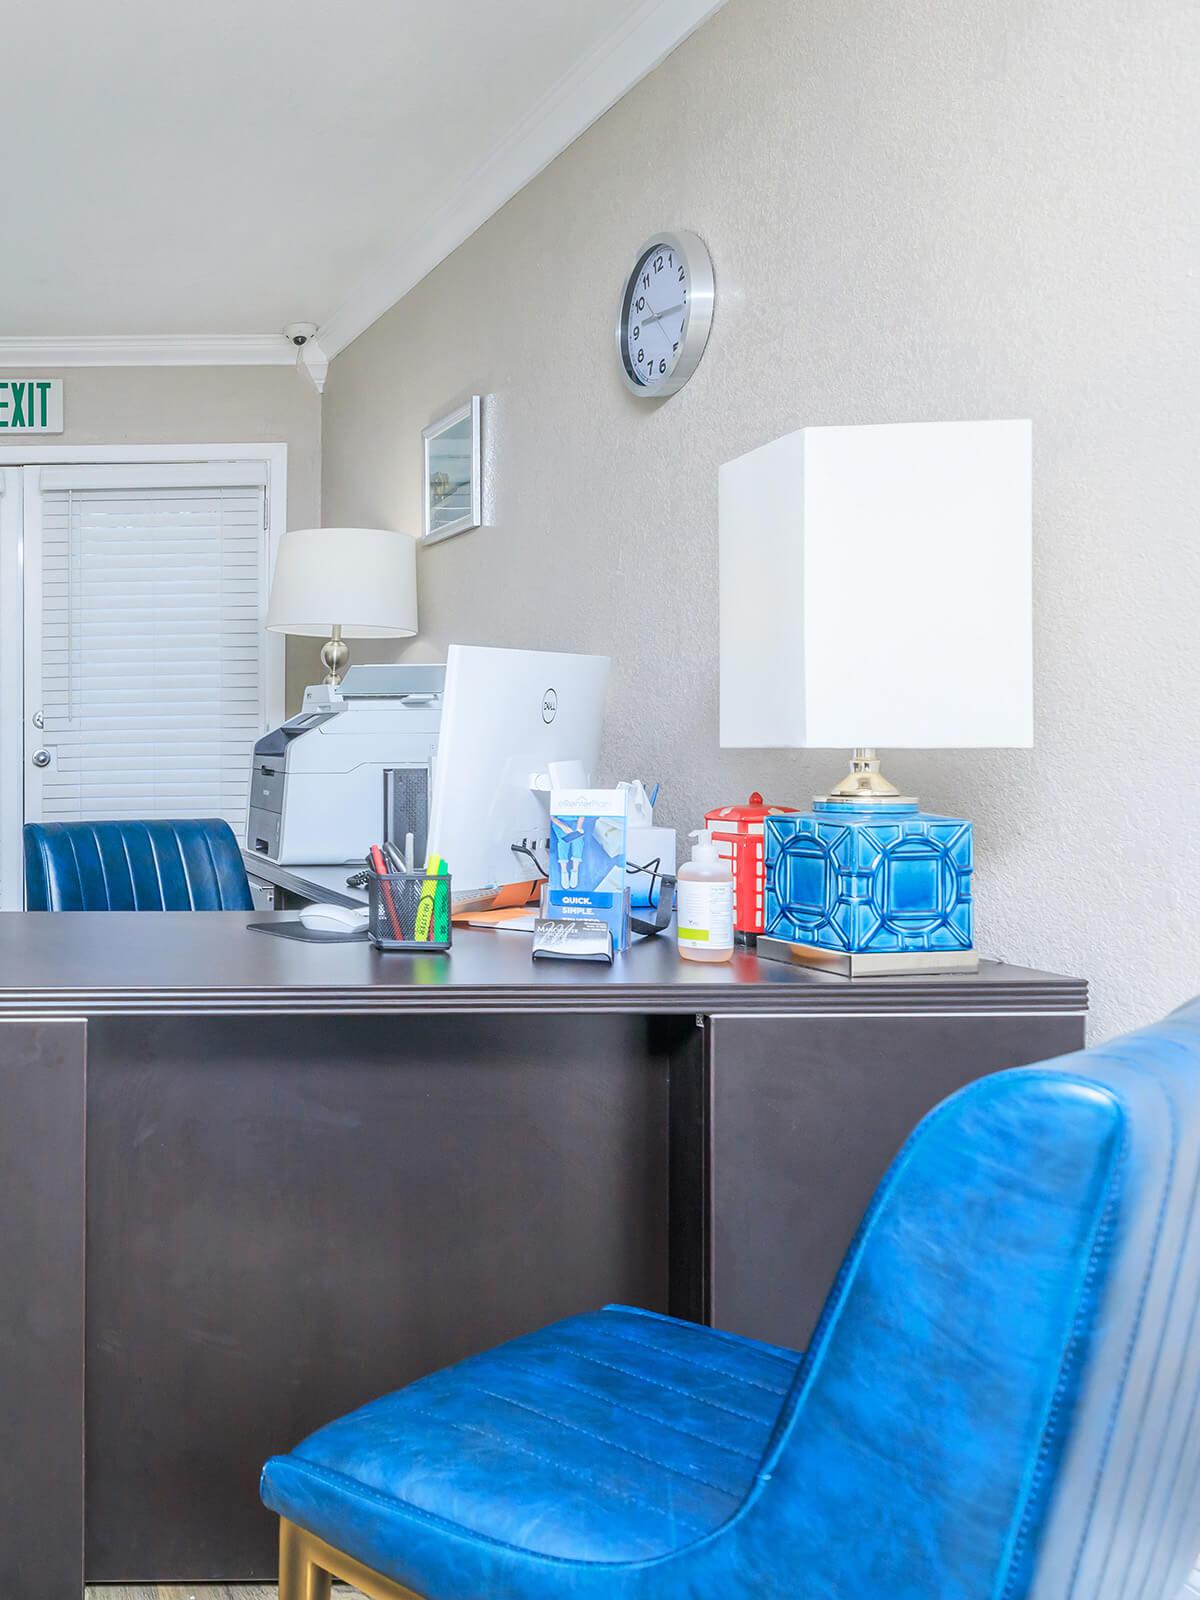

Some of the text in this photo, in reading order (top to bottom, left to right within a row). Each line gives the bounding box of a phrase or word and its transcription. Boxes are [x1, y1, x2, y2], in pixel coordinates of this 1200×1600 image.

[653, 256, 664, 274] 12
[669, 254, 673, 268] 1
[678, 266, 685, 281] 2
[643, 273, 650, 290] 11
[635, 296, 645, 313] 10
[633, 326, 639, 340] 9
[637, 349, 644, 363] 8
[647, 360, 653, 376] 7
[659, 358, 666, 374] 6
[562, 896, 592, 904] QUICK.
[562, 907, 594, 915] SIMPLE.
